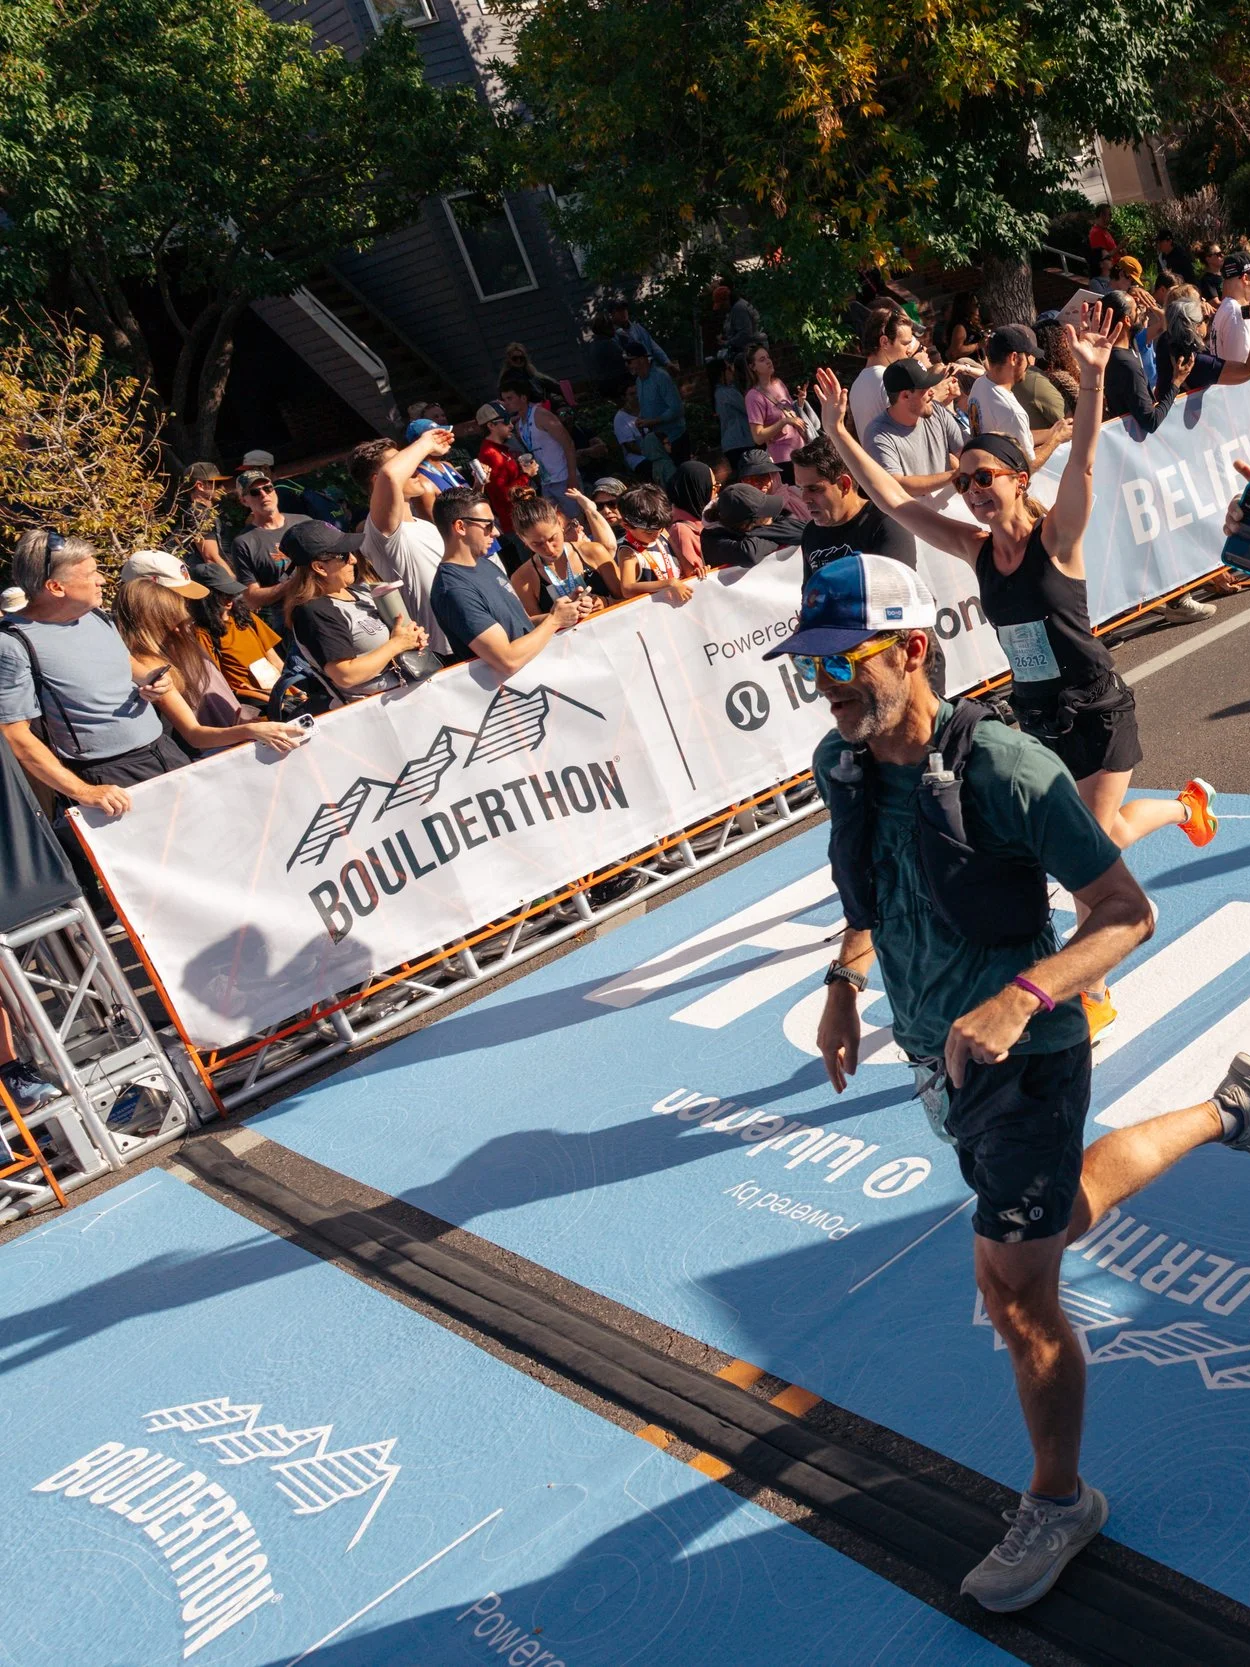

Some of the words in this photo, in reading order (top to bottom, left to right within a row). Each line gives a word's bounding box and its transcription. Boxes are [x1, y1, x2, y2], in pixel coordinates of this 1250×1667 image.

[703, 610, 801, 666] Powered
[1015, 654, 1048, 668] 26212
[308, 760, 630, 946] BOULDERTHON
[652, 1087, 881, 1184] lululemon
[722, 1179, 760, 1210] by
[755, 1191, 862, 1241] Powered
[31, 1441, 275, 1660] BOULDERTHON
